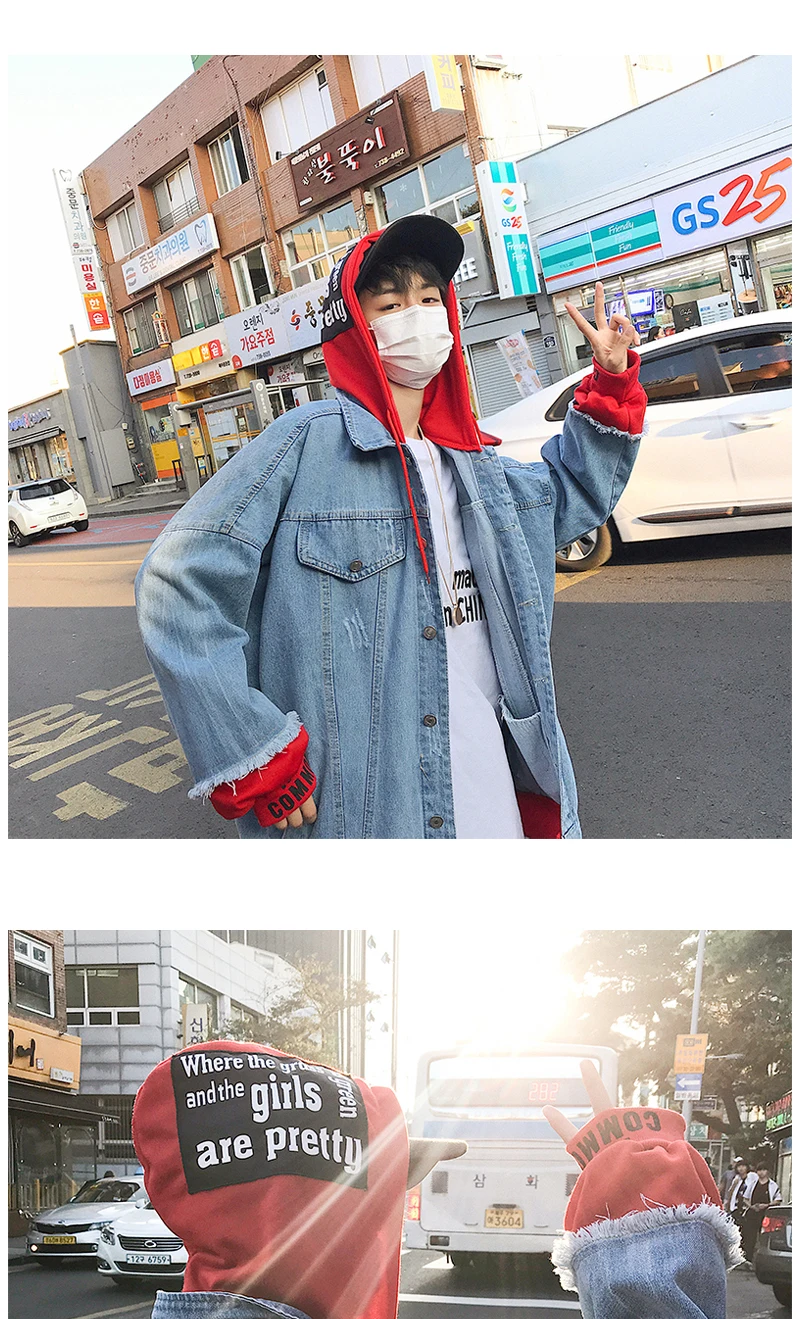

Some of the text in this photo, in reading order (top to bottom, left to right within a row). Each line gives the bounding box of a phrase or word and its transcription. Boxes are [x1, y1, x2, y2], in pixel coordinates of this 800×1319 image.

[671, 157, 792, 236] GS25
[501, 215, 523, 229] GS25
[608, 220, 635, 236] Friendly
[139, 230, 191, 274] 중문치과의원
[618, 242, 632, 253] Fun
[81, 264, 97, 291] 미용실
[243, 313, 265, 331] 오렌지
[240, 327, 275, 352] 가요주점
[180, 1053, 243, 1078] Where
[248, 1055, 276, 1069] the
[186, 1073, 322, 1123] and the girls
[528, 1082, 560, 1102] 282
[196, 1126, 363, 1175] are pretty
[473, 1174, 539, 1189] 삼 화
